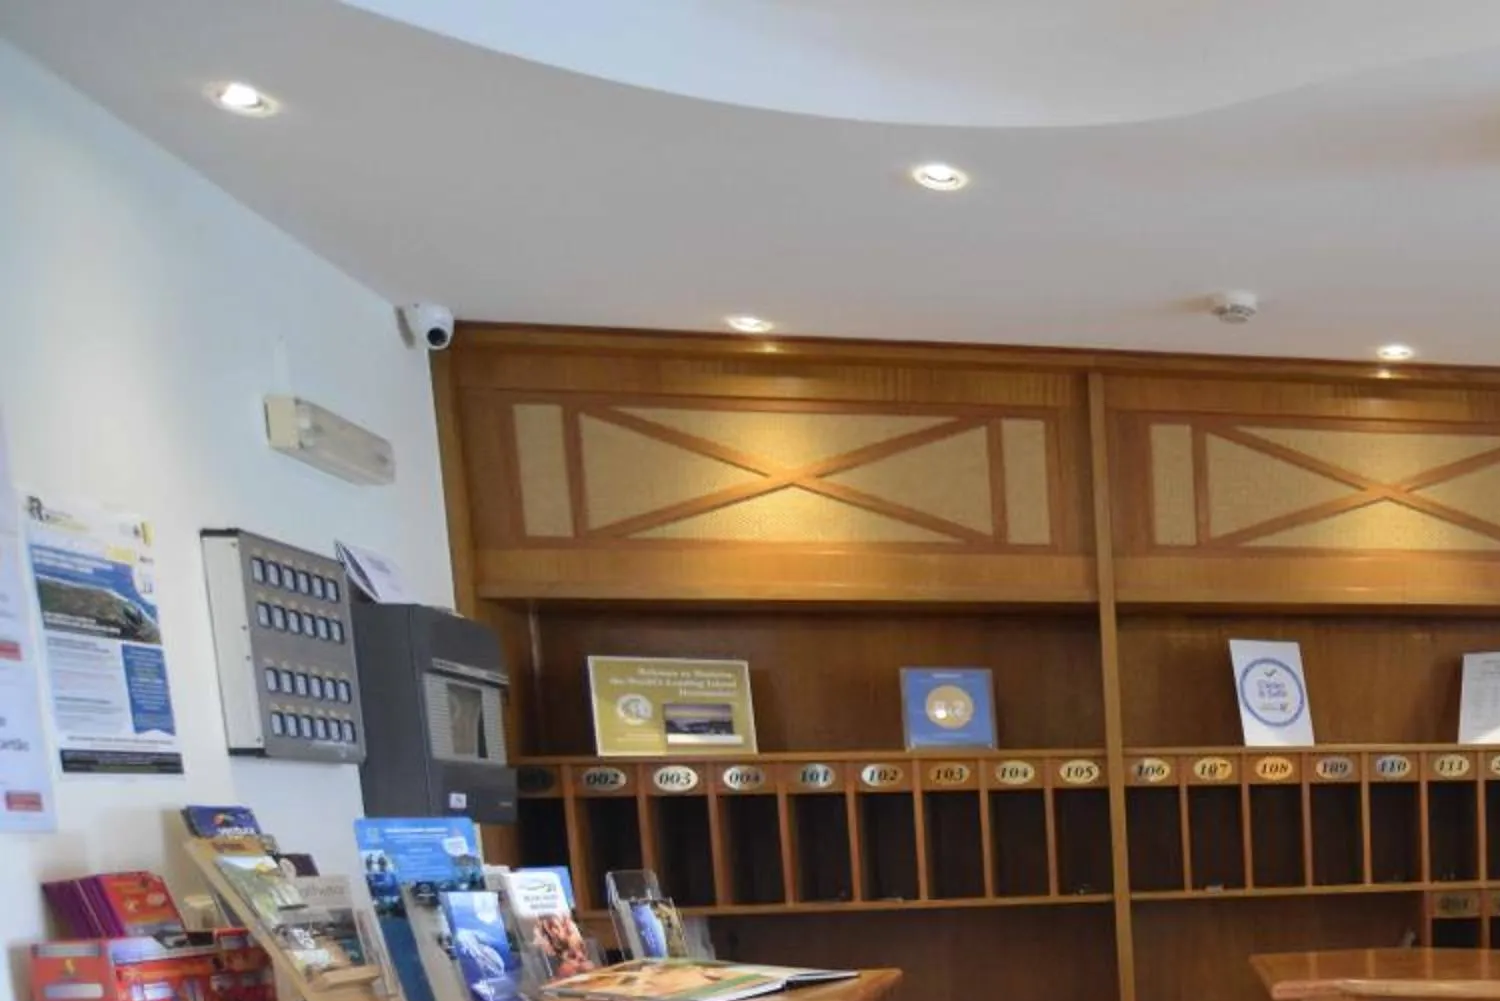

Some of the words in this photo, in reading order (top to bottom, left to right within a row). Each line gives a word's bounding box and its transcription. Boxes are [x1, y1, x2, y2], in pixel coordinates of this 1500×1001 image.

[1065, 766, 1094, 779] 105
[1136, 763, 1166, 776] 106
[1199, 763, 1228, 776] 107
[1261, 762, 1291, 774] 108
[1321, 762, 1349, 774] 109
[1380, 760, 1408, 773] 110
[1438, 760, 1464, 772] 111
[586, 771, 619, 785] 002
[659, 771, 691, 785] 003
[801, 767, 830, 782] 101
[868, 768, 898, 781] 102
[934, 768, 965, 781] 103
[1000, 767, 1030, 779] 104
